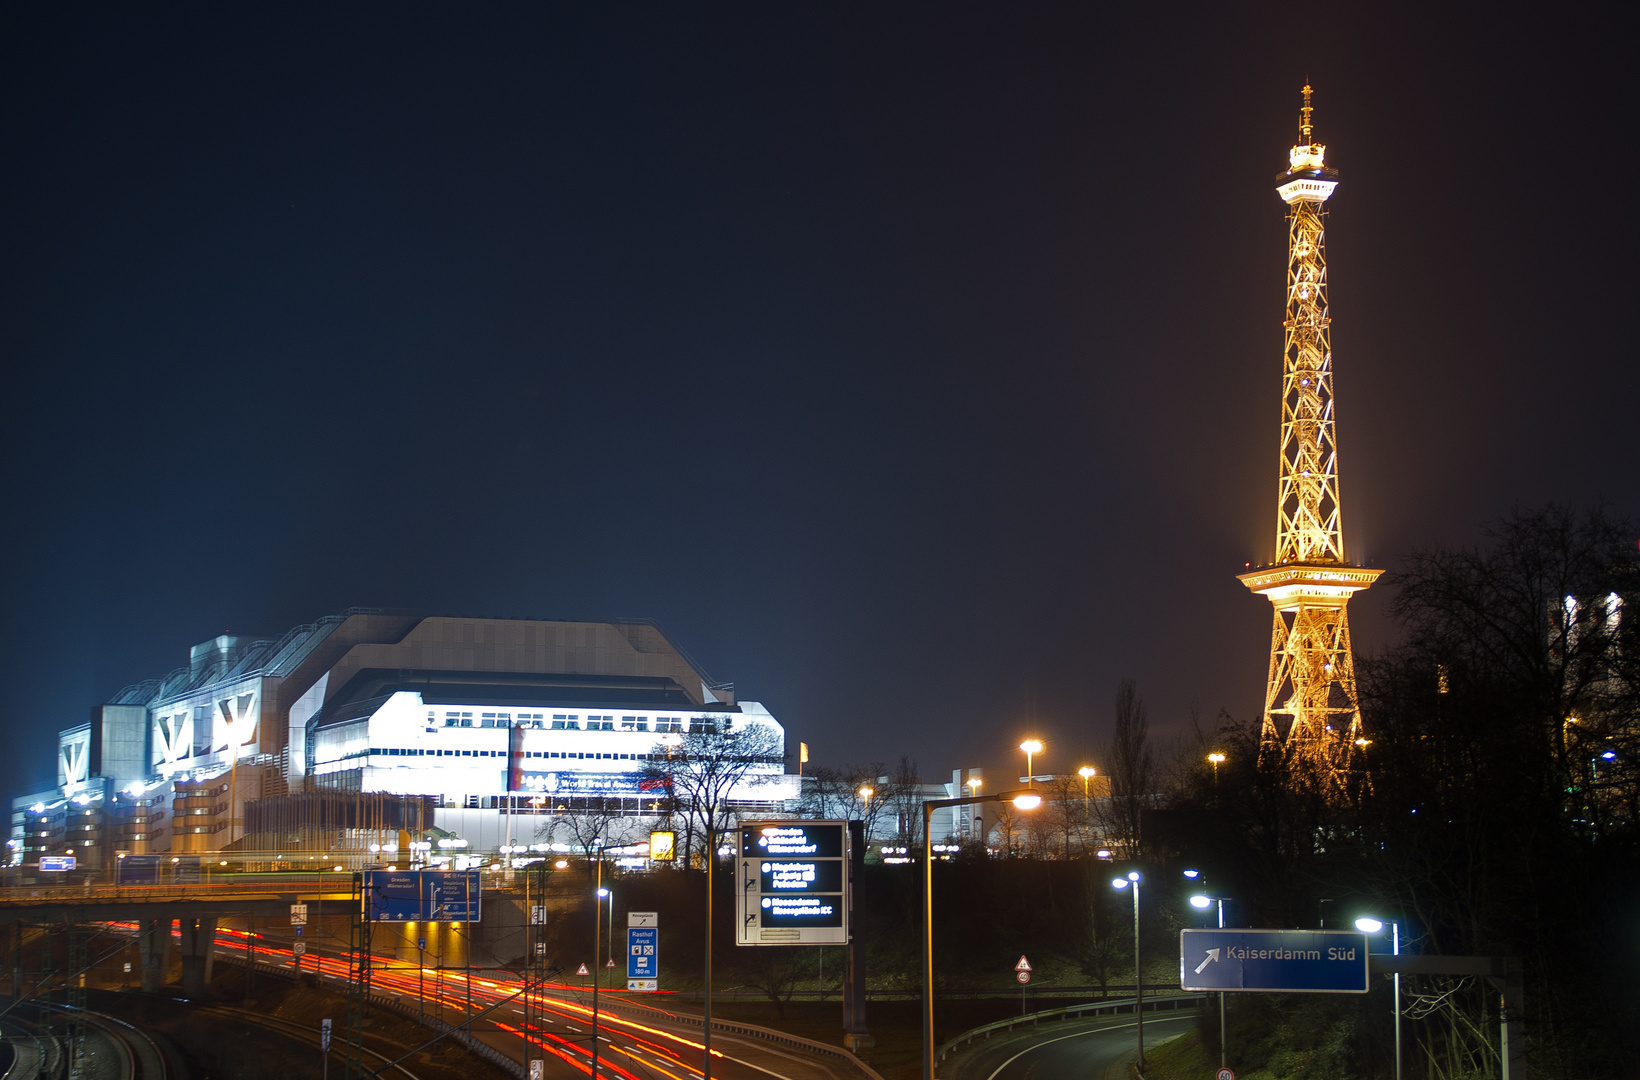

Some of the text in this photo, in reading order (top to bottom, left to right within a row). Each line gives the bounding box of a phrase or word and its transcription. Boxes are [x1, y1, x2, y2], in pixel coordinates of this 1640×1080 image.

[1226, 946, 1356, 961] Kaiserdamm Süd
[1220, 1072, 1231, 1080] 60
